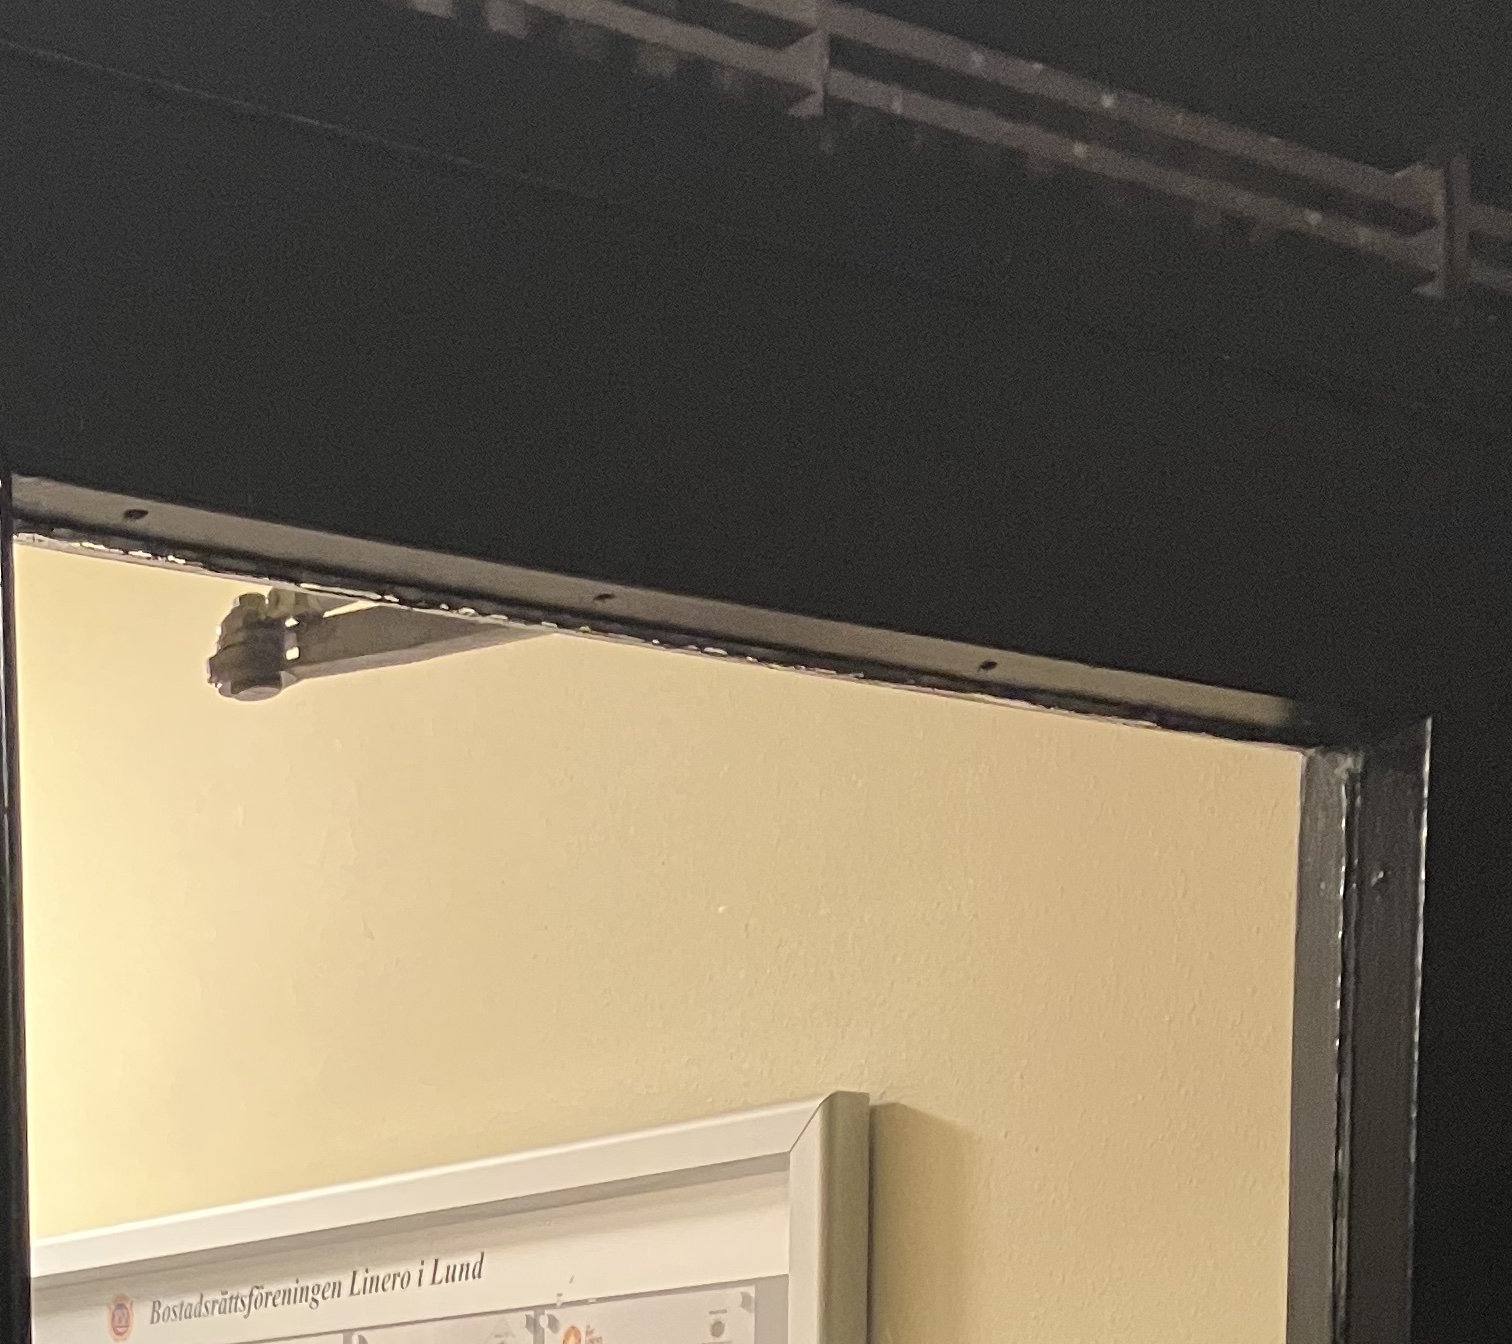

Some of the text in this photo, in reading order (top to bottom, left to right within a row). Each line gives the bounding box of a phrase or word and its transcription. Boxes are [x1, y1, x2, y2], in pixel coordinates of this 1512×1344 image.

[149, 1252, 485, 1325] Bostadsrättsföreningen Linero i Lund
